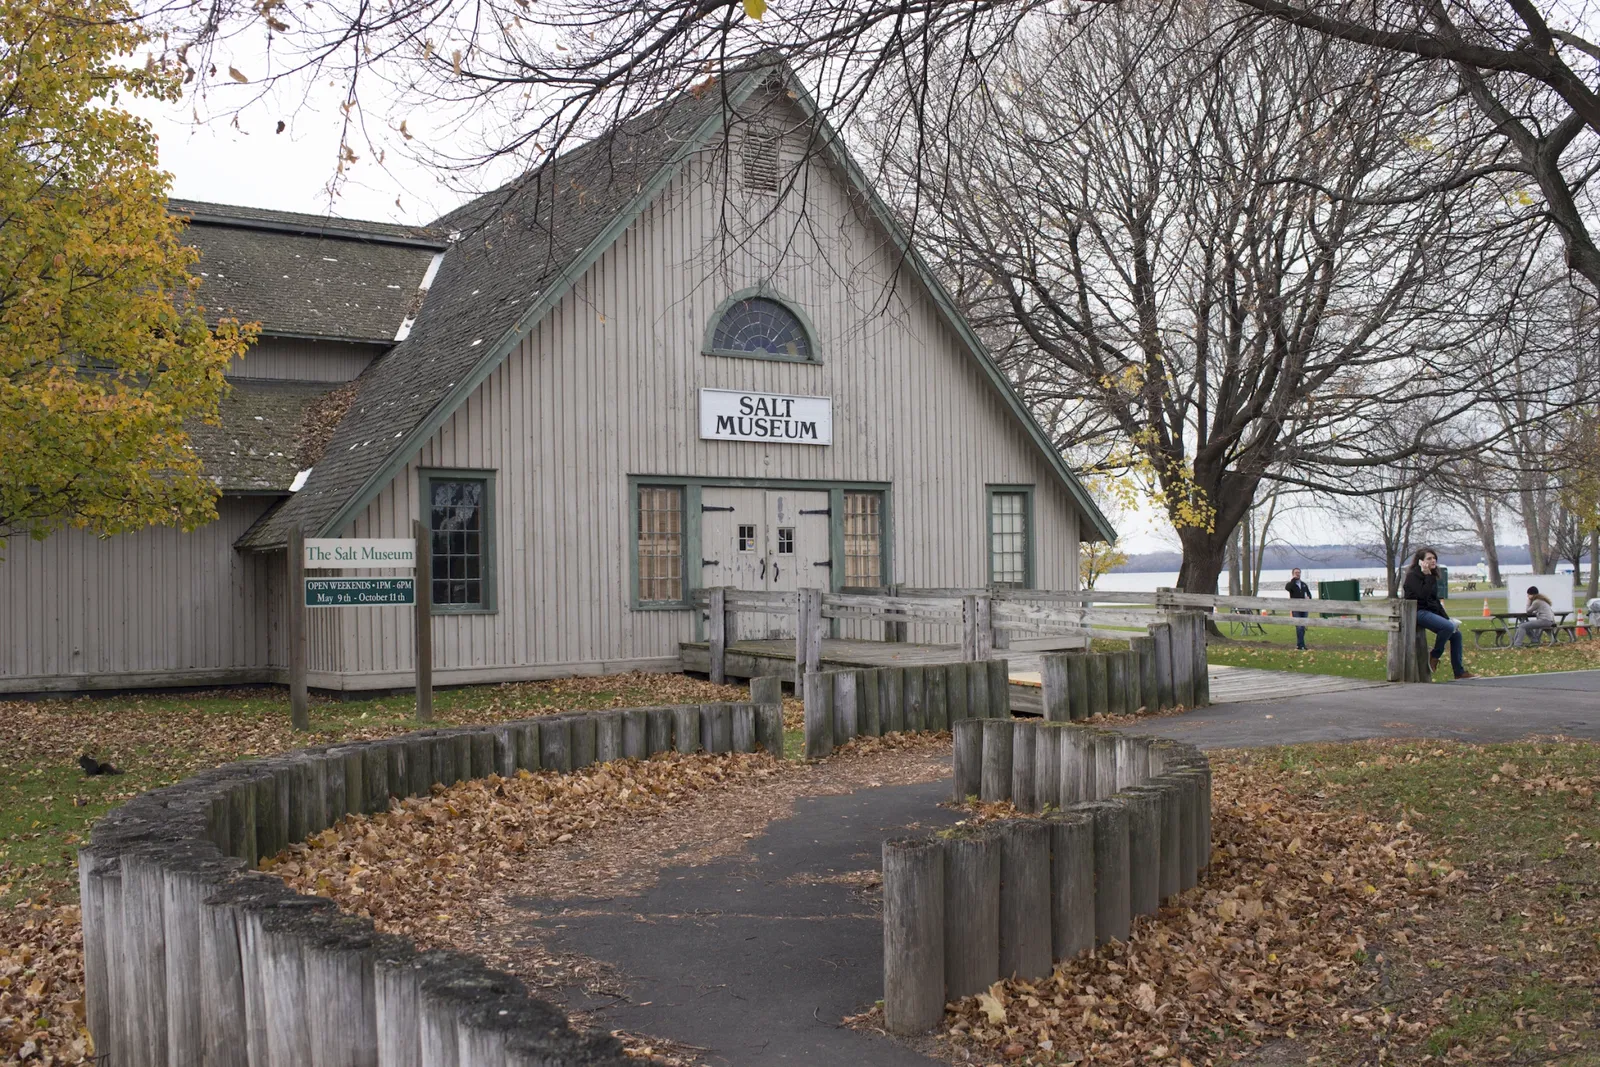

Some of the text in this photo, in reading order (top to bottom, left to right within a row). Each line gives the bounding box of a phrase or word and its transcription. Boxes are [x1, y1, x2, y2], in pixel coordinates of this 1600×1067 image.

[739, 396, 794, 417] SALT
[715, 415, 818, 439] MUSEUM
[306, 546, 413, 560] The Salt Museum
[330, 582, 370, 590] WEEKENDS
[397, 581, 411, 589] 6PM
[317, 593, 333, 604] May
[359, 593, 387, 601] October
